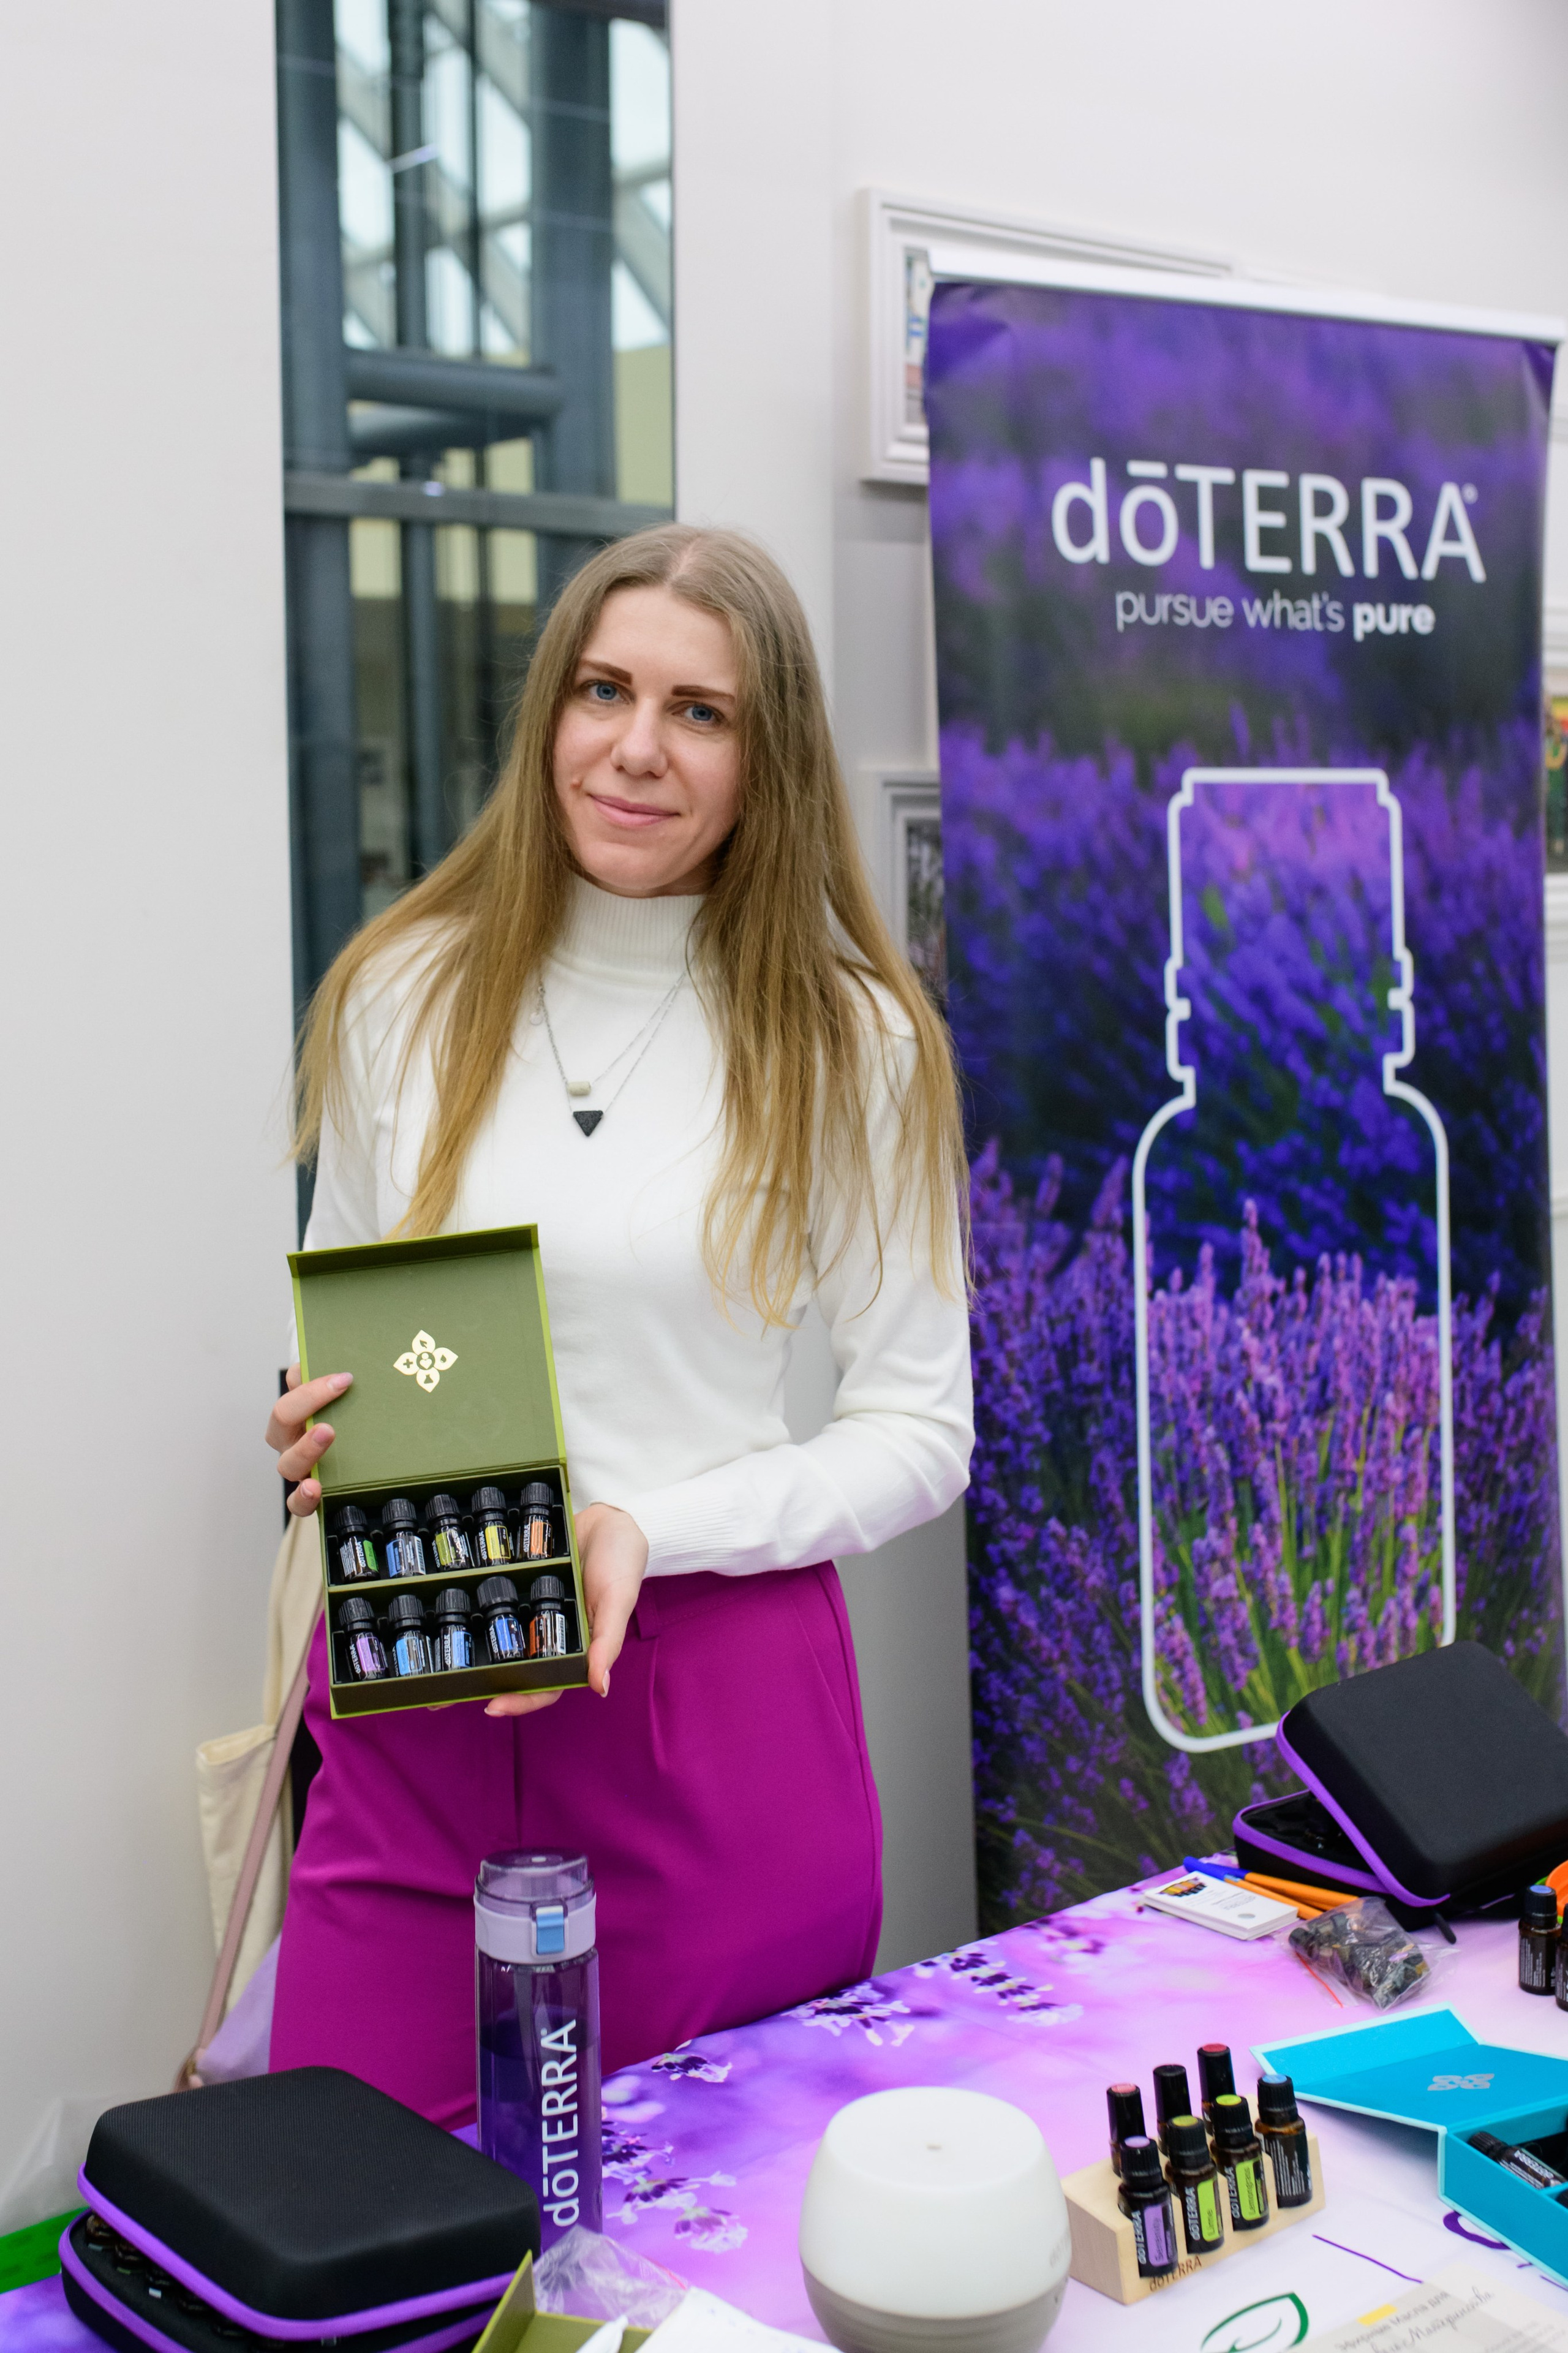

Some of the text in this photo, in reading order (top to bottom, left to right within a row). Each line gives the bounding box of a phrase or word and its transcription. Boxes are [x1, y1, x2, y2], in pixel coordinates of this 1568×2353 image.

[1115, 590, 1436, 642] pursue what's pure
[1207, 2208, 1215, 2237] Lime
